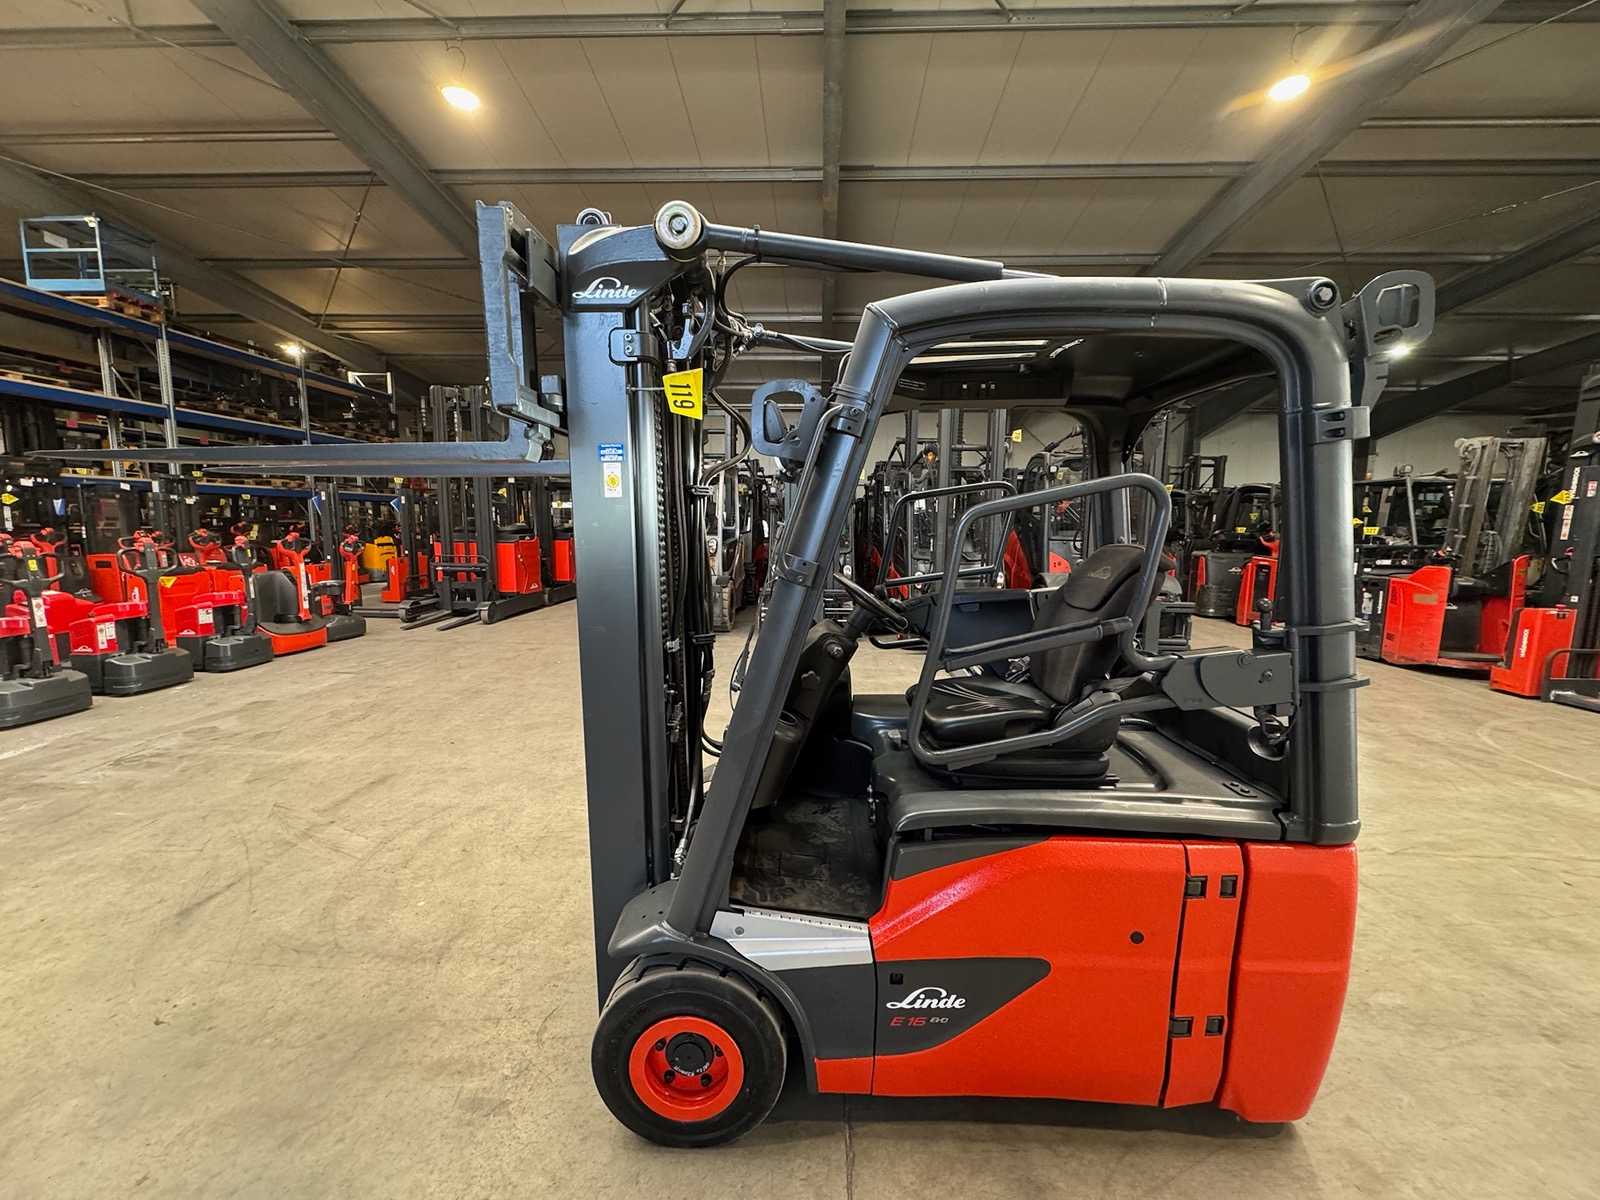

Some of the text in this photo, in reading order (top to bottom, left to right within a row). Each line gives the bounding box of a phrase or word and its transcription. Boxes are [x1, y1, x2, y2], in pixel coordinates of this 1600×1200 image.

[572, 276, 637, 299] Linde
[669, 383, 695, 409] 119
[886, 986, 966, 1009] Linde
